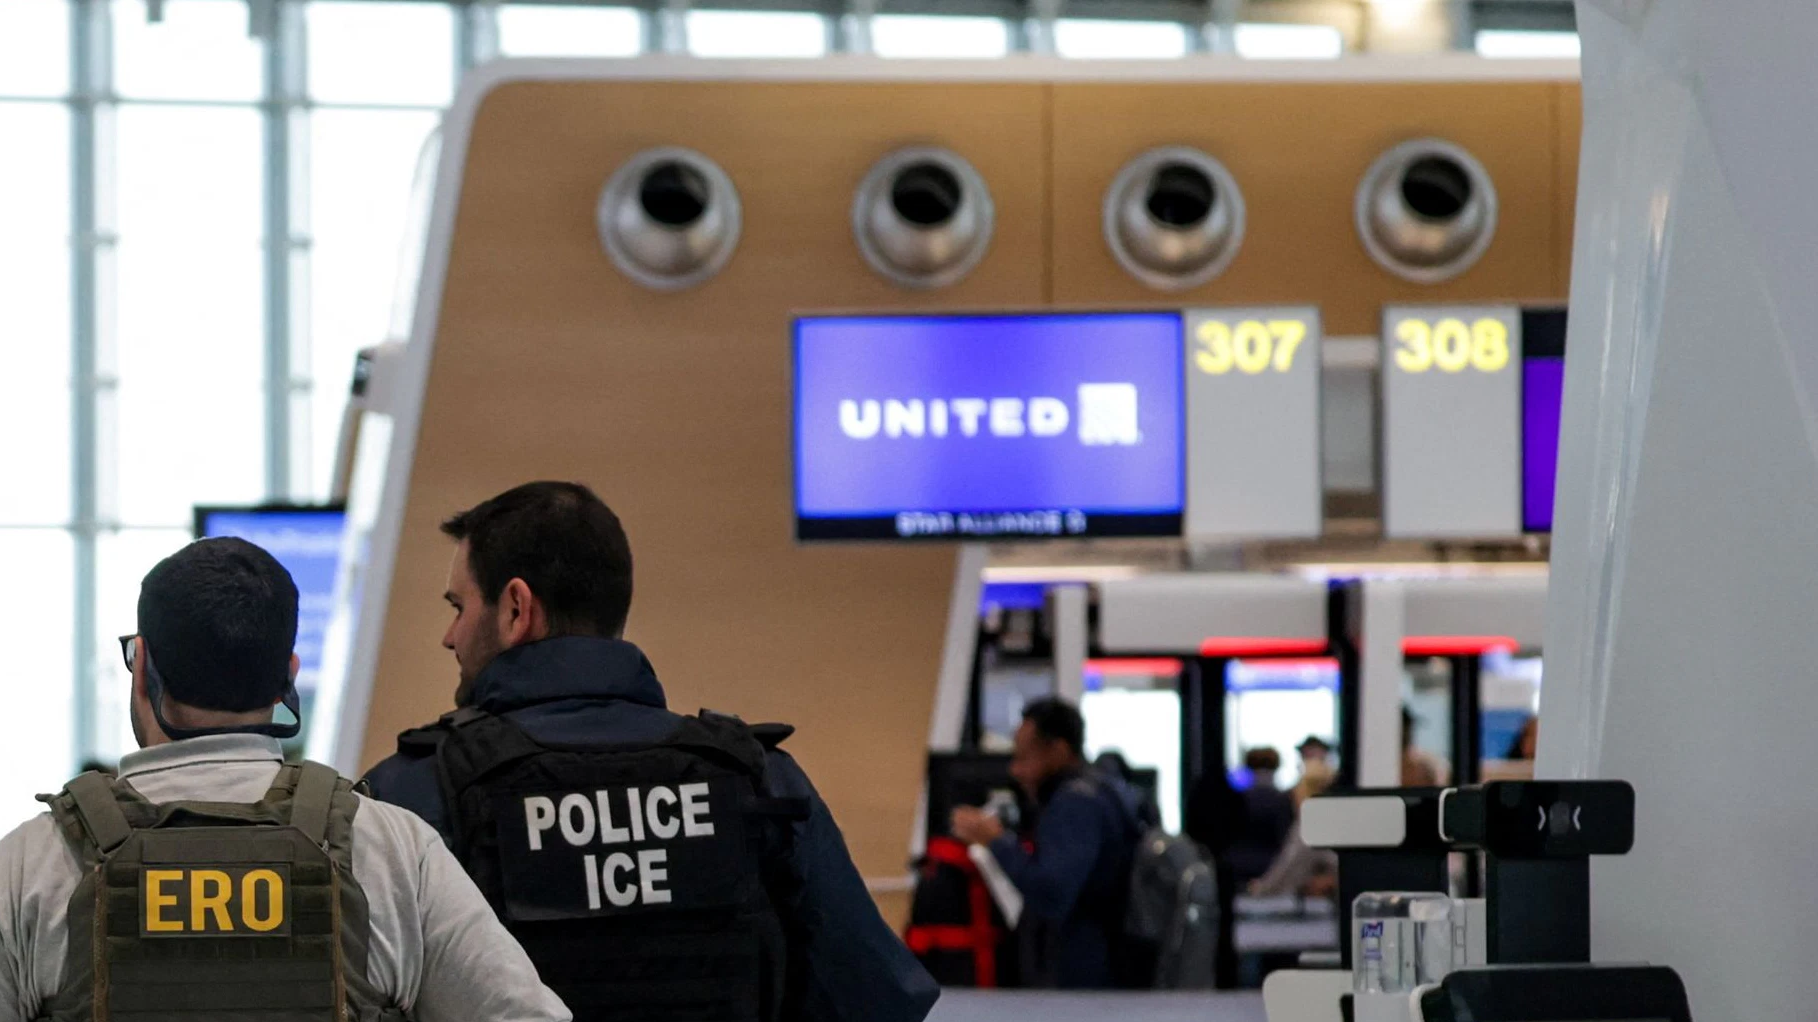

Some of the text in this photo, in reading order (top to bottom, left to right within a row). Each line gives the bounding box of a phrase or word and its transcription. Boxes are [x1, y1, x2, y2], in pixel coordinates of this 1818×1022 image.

[1195, 319, 1306, 374] 307
[1394, 317, 1509, 373] 308
[839, 397, 1069, 439] UNITED
[524, 782, 715, 850] POLICE
[146, 869, 283, 931] ERO
[584, 849, 672, 910] ICE
